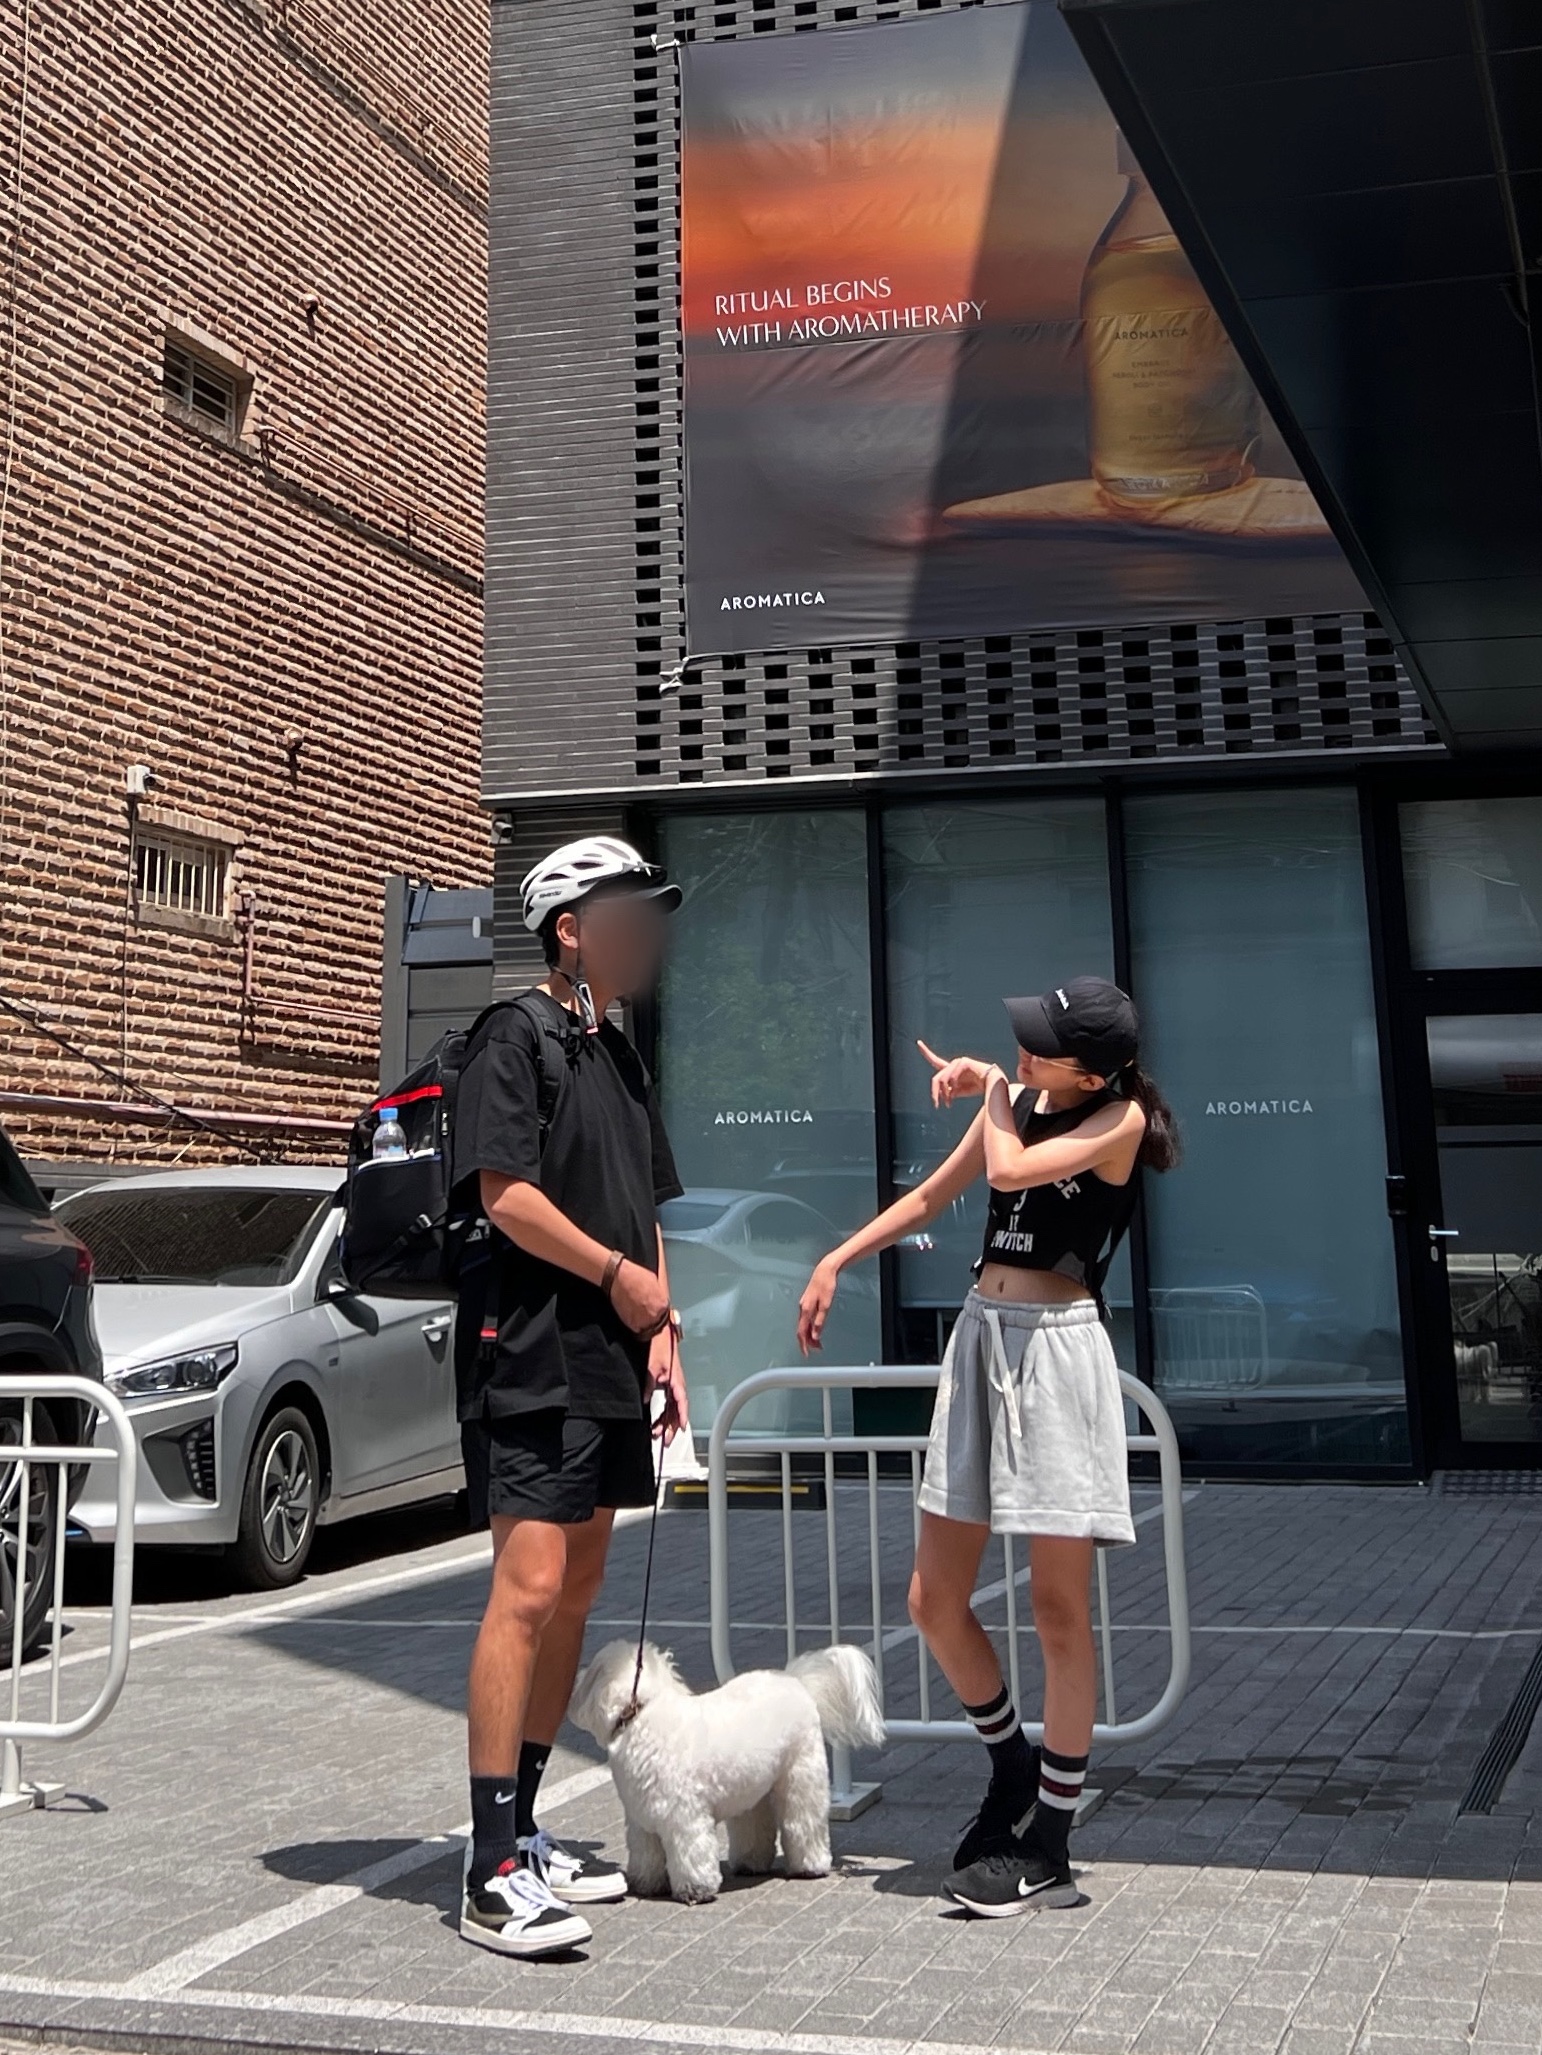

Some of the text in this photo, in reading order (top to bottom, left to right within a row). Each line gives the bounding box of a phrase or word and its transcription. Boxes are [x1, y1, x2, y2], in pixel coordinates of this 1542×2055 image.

[715, 276, 892, 315] RITUAL BEGINS
[715, 300, 988, 346] WITH AROMATHERAPY
[1114, 327, 1189, 340] AROMATICA
[720, 591, 826, 611] AROMATICA
[1206, 1099, 1314, 1116] AROMATICA
[714, 1110, 813, 1125] AROMATICA
